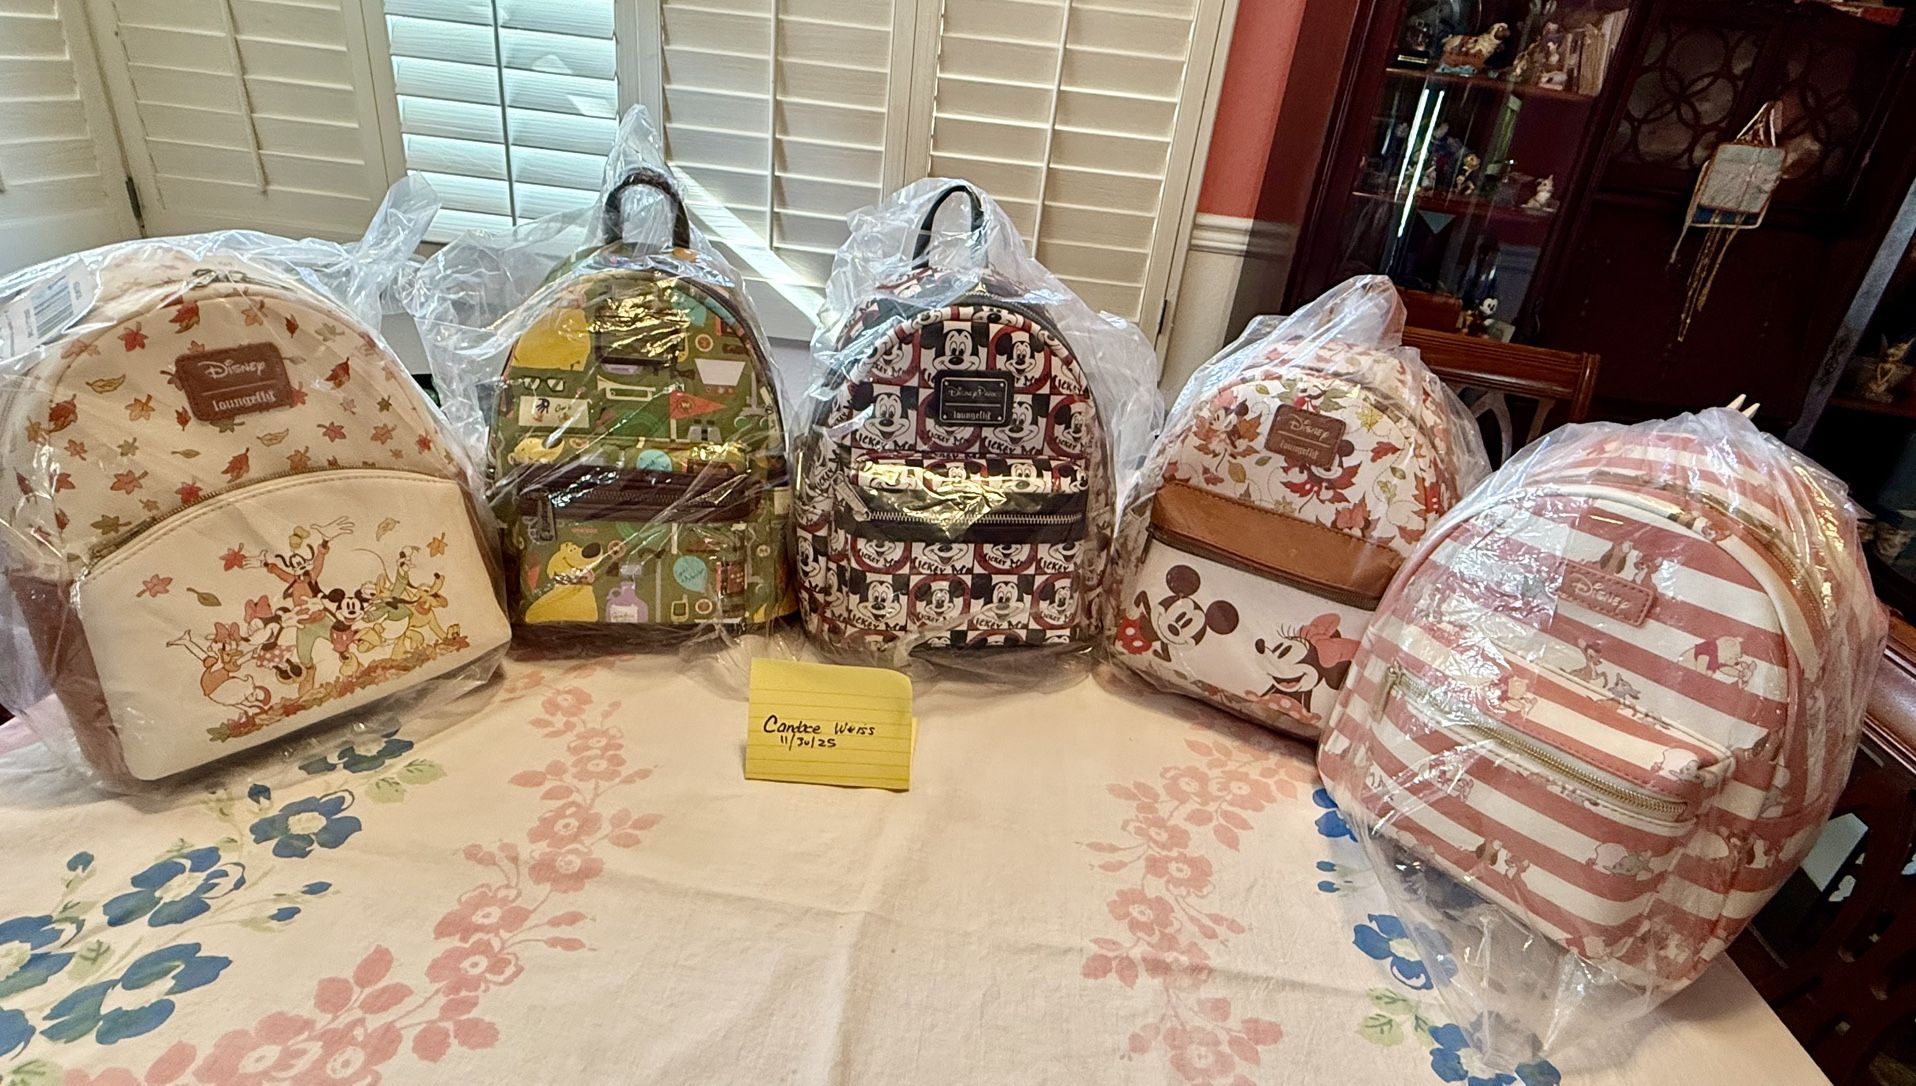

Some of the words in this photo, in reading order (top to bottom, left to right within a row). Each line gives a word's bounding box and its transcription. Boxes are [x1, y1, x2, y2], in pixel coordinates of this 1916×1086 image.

[198, 360, 266, 379] Disney
[946, 386, 978, 399] Disney
[1288, 413, 1330, 441] Disney
[1570, 573, 1631, 613] Disney
[780, 733, 837, 751] 11/30/25
